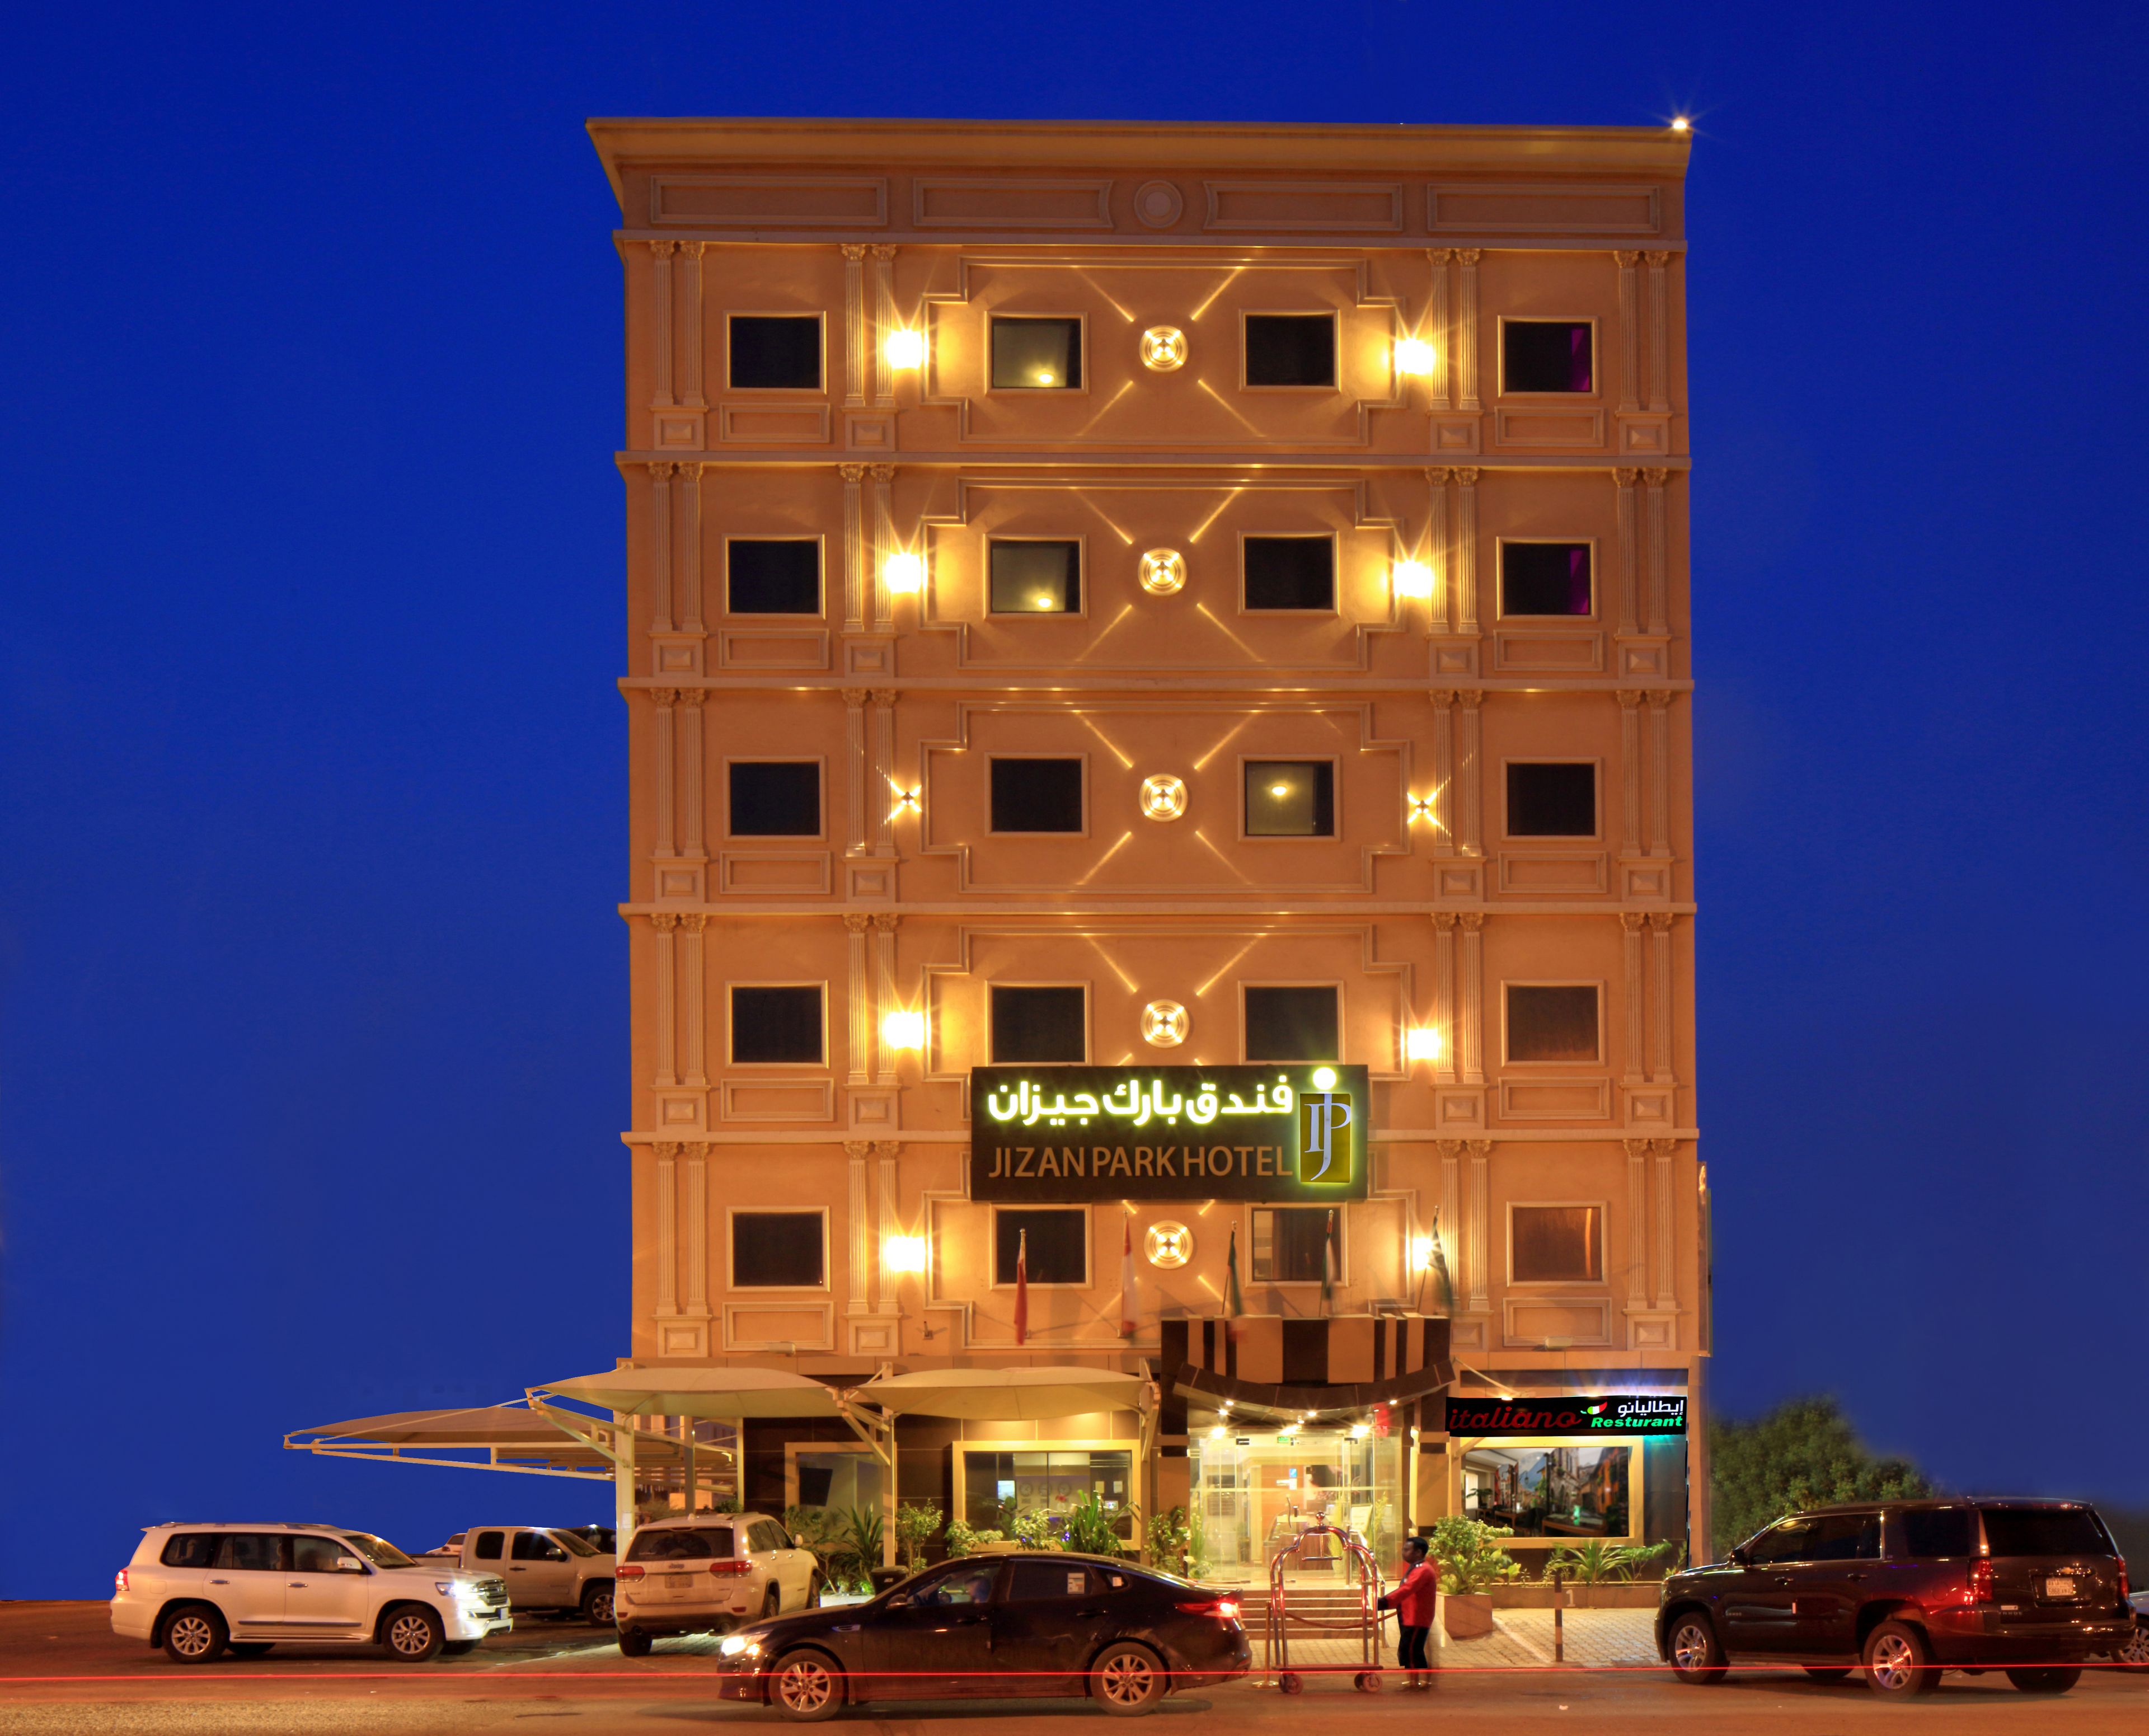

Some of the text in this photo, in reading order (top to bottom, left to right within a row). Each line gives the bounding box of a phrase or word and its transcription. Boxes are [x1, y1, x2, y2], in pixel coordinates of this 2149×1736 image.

[988, 1075, 1293, 1127] فندق بارك جيزان
[988, 1146, 1293, 1177] JIZAN PARK HOTEL
[1449, 1406, 1583, 1430] italiano
[1617, 1400, 1684, 1418] إيطاليانو
[1590, 1416, 1683, 1428] Resturant
[1566, 1589, 1576, 1607] 1
